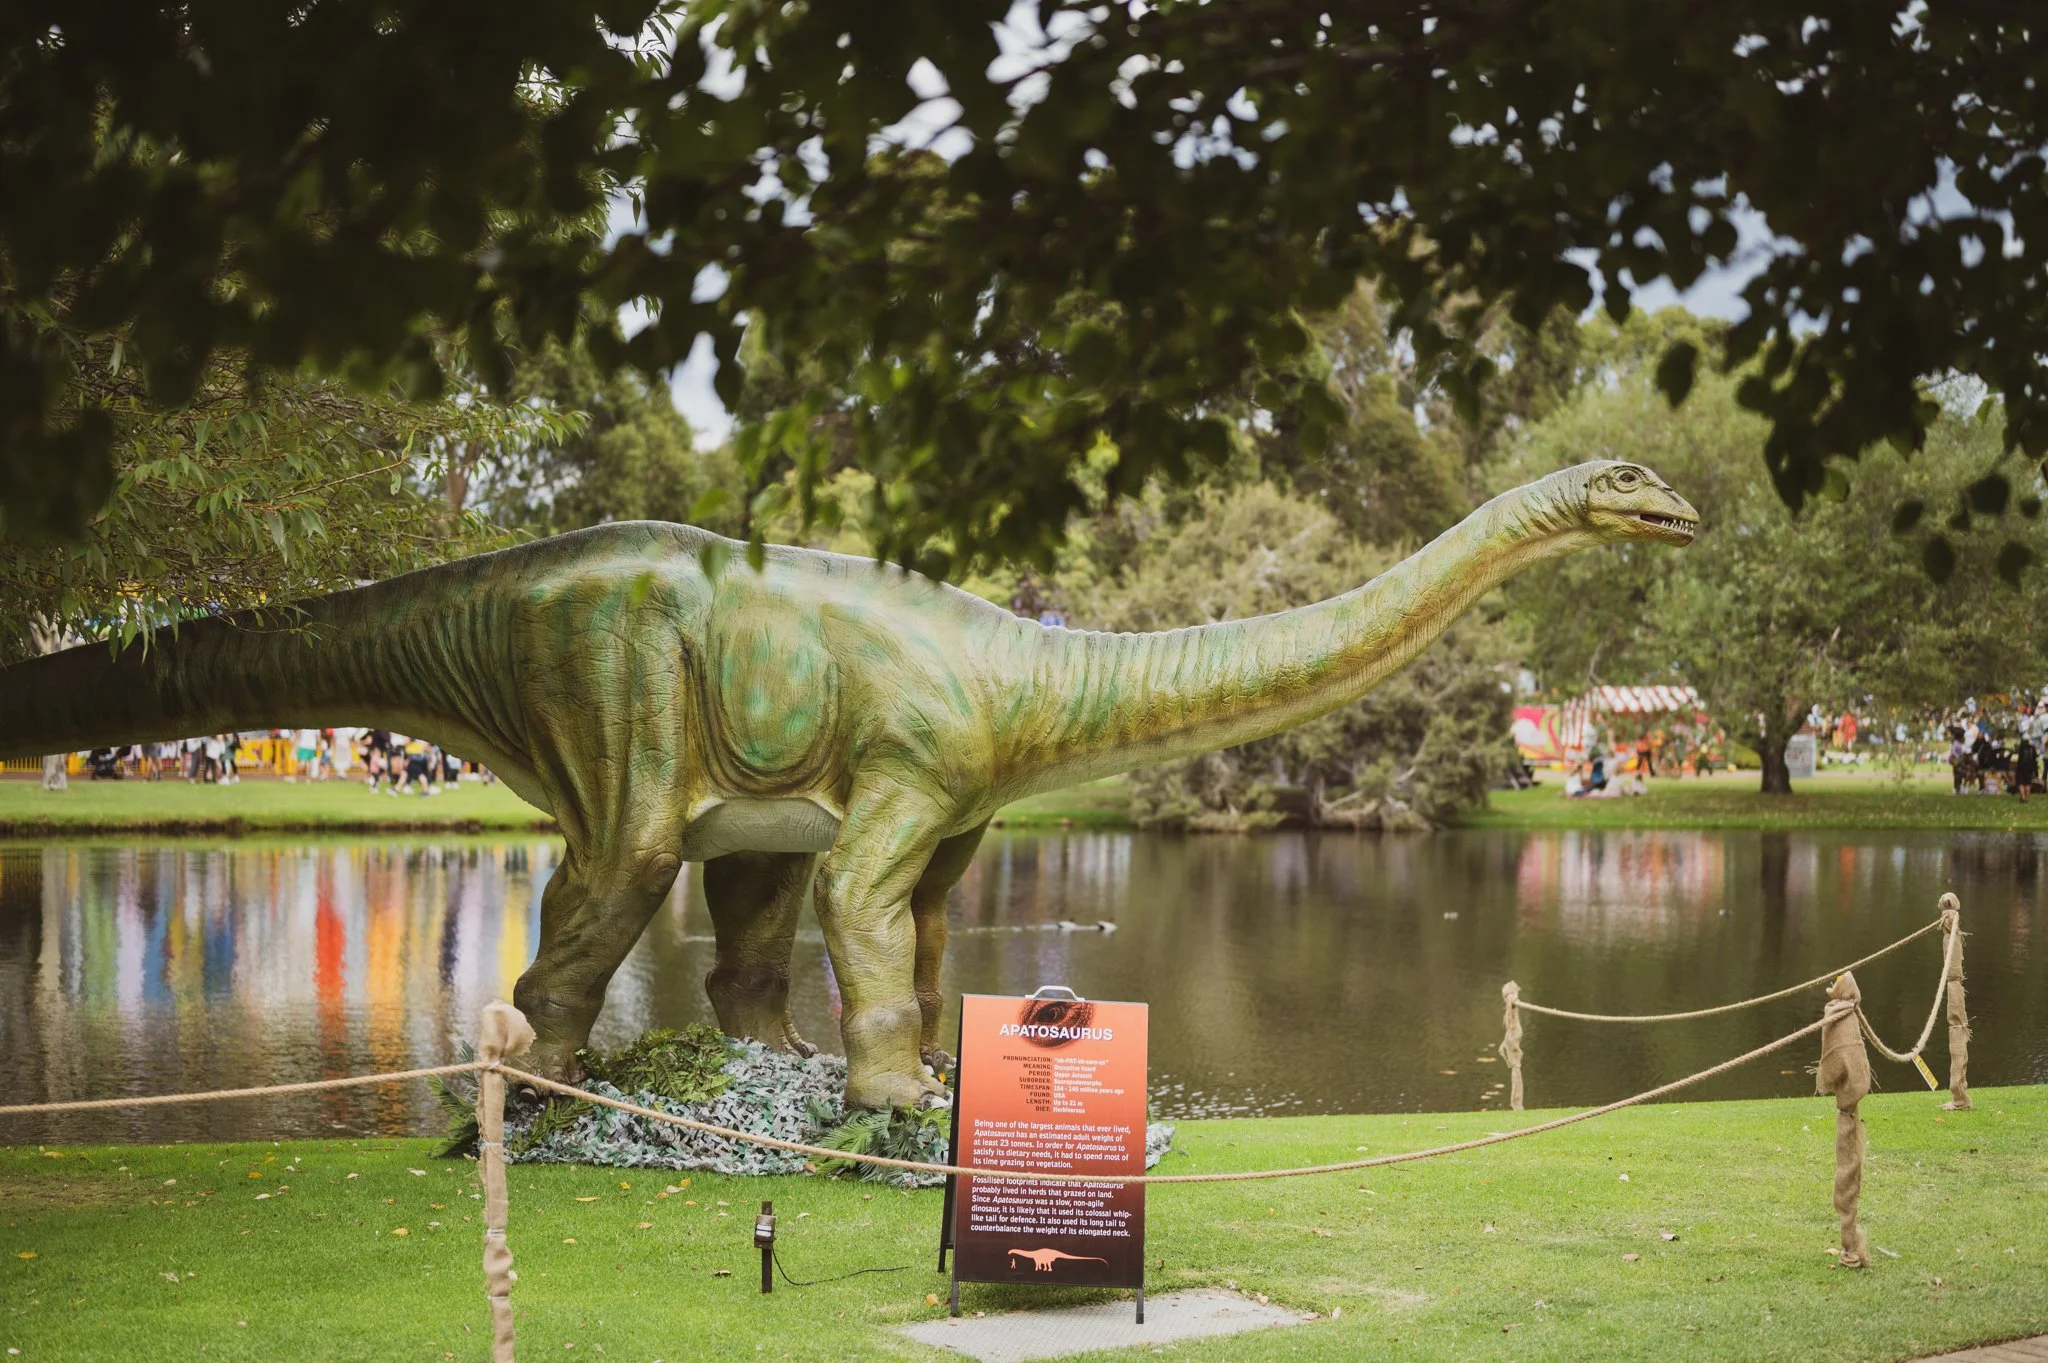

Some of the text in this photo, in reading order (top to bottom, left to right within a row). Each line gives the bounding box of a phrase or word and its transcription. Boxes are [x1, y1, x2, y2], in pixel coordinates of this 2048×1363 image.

[1000, 1024, 1113, 1040] APATOSAURUS
[975, 1120, 993, 1128] Being
[1114, 1125, 1130, 1134] lived,
[1076, 1143, 1117, 1151] Apatosaurus
[1006, 1149, 1030, 1158] dietary
[973, 1176, 1004, 1184] Fossilised
[1007, 1178, 1037, 1186] footprints
[972, 1186, 1001, 1194] probably
[992, 1196, 1033, 1204] Apatosaurus
[1074, 1200, 1104, 1208] non-agile
[972, 1205, 1000, 1213] dinosaur,
[1017, 1206, 1035, 1215] likely
[1113, 1210, 1131, 1218] whip-
[1090, 1219, 1103, 1227] long
[1078, 1228, 1111, 1236] elongated
